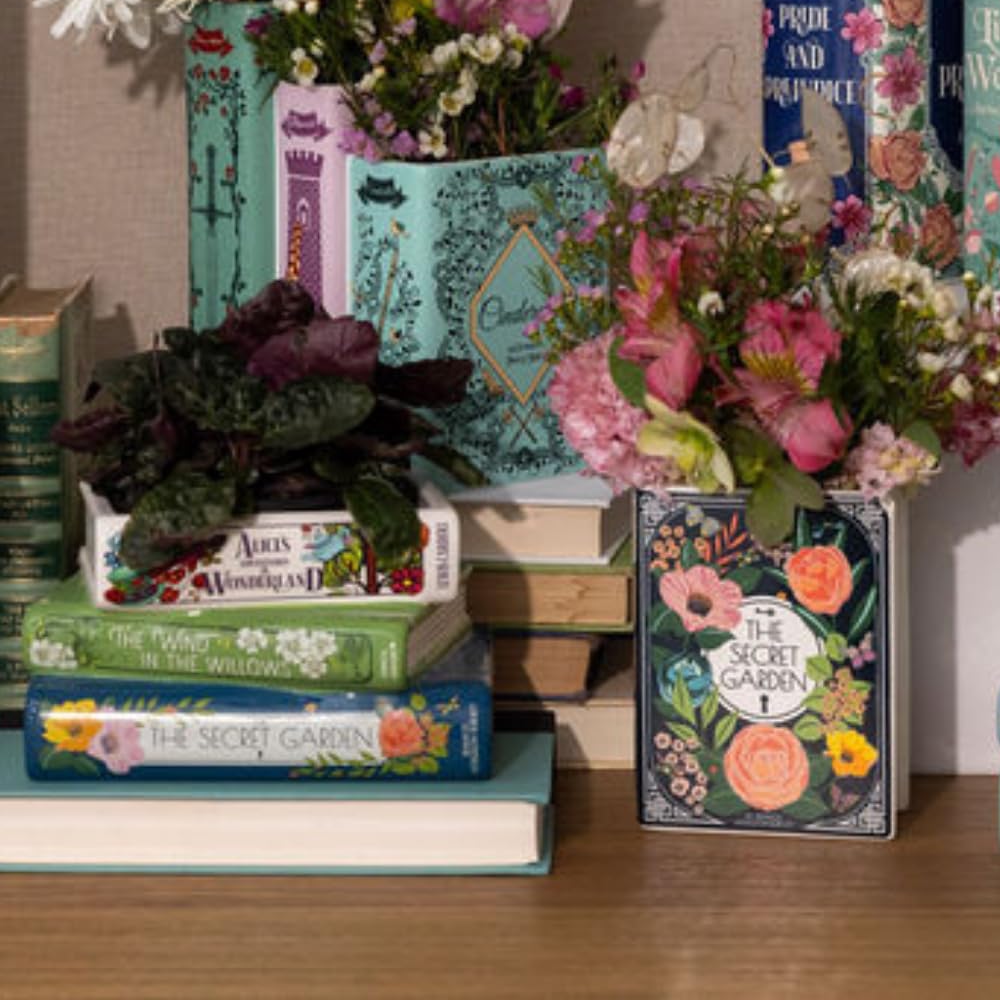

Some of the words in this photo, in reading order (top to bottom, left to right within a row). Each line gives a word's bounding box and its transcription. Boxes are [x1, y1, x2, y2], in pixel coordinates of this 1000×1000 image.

[779, 4, 831, 36] PRIDE
[784, 40, 825, 70] AND
[745, 618, 783, 643] THE
[728, 642, 800, 667] SECRET
[719, 667, 808, 694] GARDEN
[150, 725, 188, 749] THE
[199, 726, 271, 750] SECRET
[279, 727, 375, 750] GARDEN
